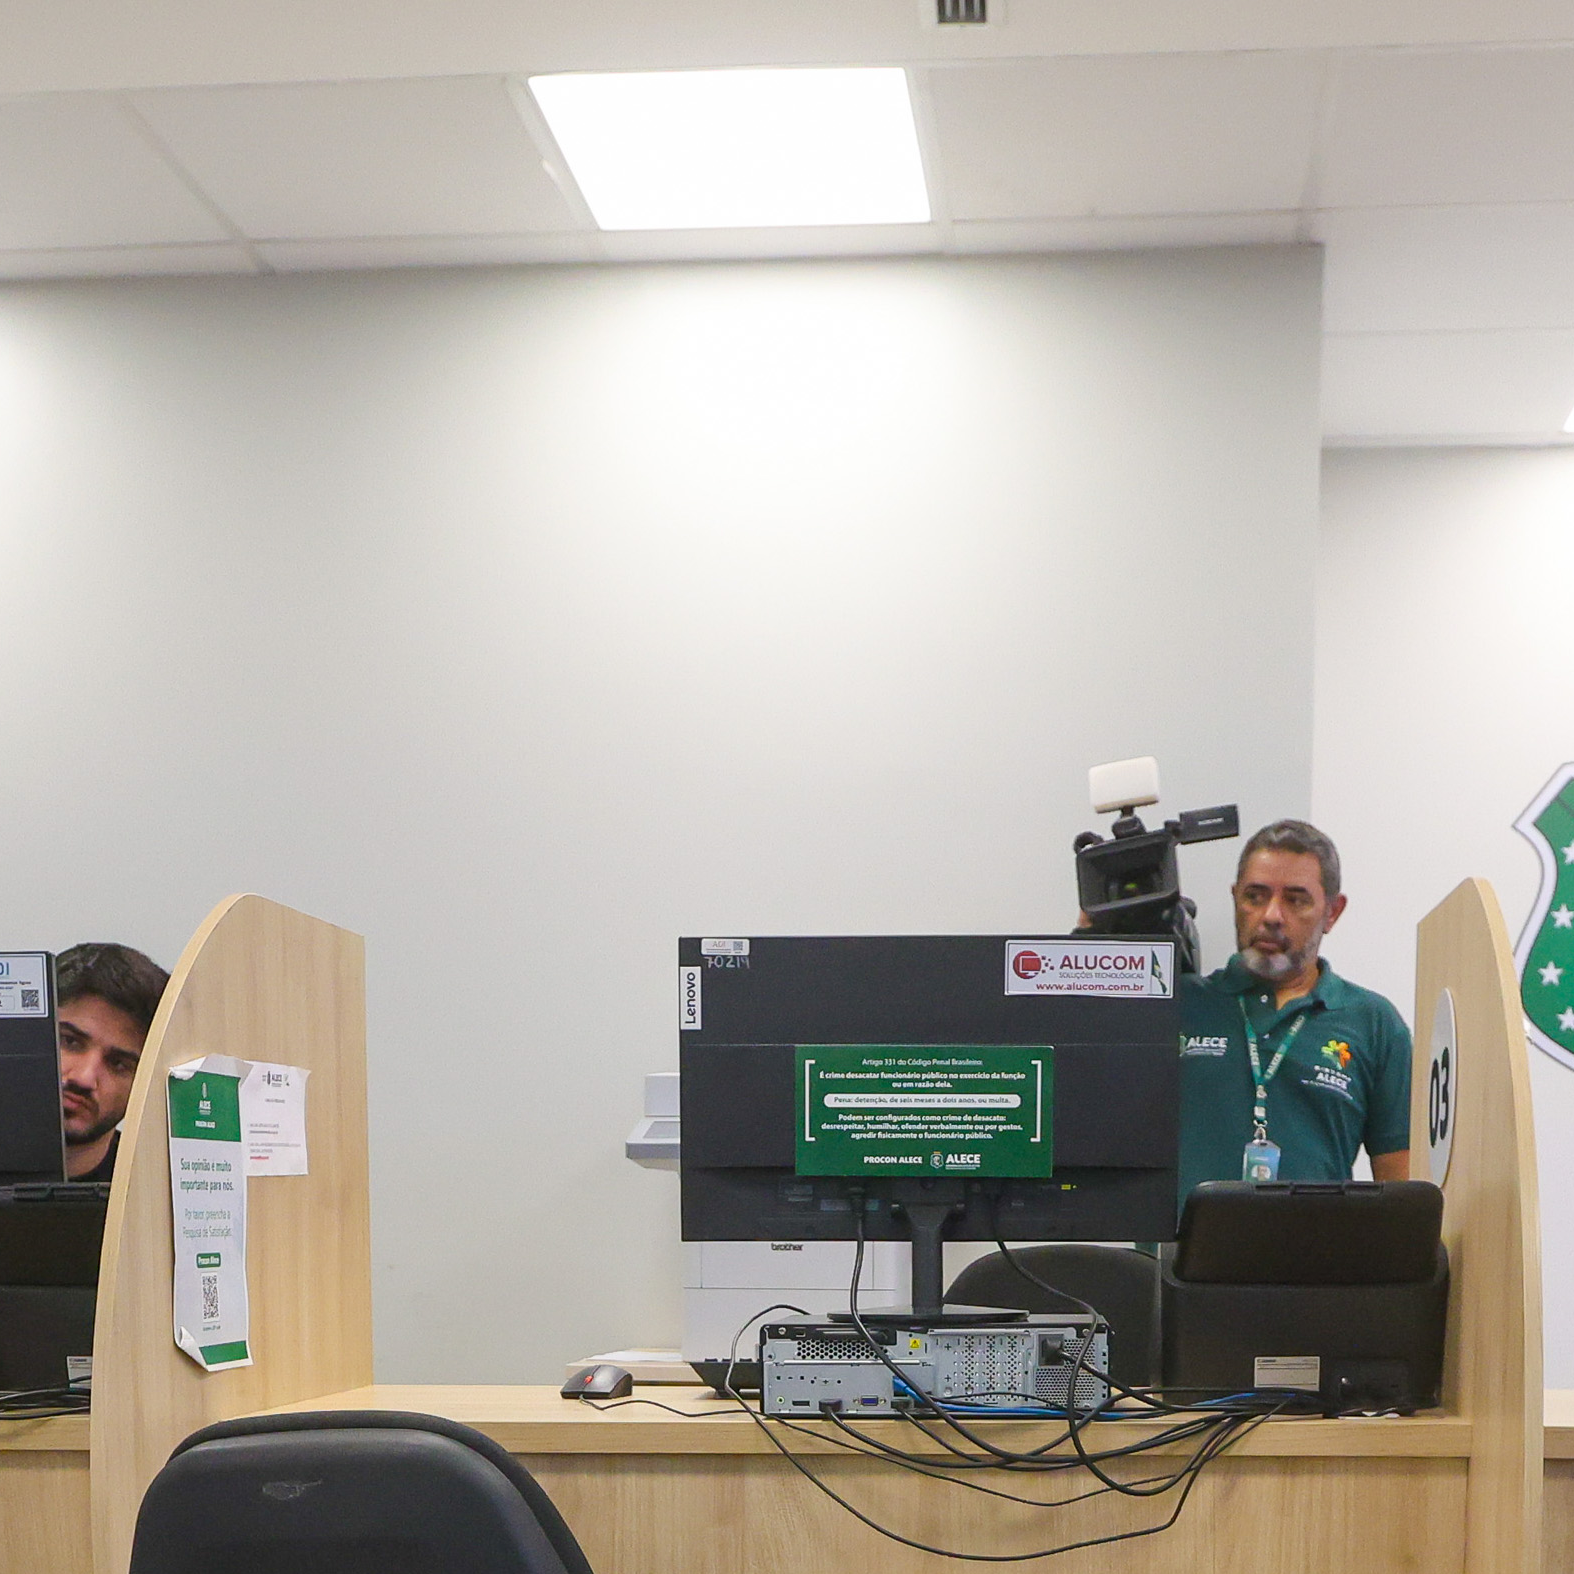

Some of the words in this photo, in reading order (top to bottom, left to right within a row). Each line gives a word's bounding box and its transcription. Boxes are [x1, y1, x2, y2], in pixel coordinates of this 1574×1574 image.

[1059, 955, 1145, 970] ALUCOM
[1059, 971, 1093, 979] SOLUÇÕES
[1095, 971, 1144, 979] TECNOLÓGICAS
[1036, 982, 1144, 991] www.alucom.com.br
[685, 972, 696, 1024] Lenovo
[1187, 1037, 1227, 1048] ALECE
[907, 1058, 931, 1066] Código
[921, 1071, 948, 1079] público
[1001, 1071, 1026, 1079] função
[1316, 1072, 1348, 1090] ALECE
[1429, 1046, 1449, 1148] 03
[875, 1114, 921, 1122] configurados
[851, 1132, 877, 1140] agredir
[965, 1132, 993, 1140] público.
[863, 1156, 897, 1164] PROCON
[898, 1156, 923, 1164] ALECE
[945, 1154, 981, 1164] ALECE
[180, 1158, 190, 1170] Sua
[191, 1158, 210, 1174] opinião
[216, 1160, 232, 1172] muito
[180, 1177, 209, 1193] importante
[210, 1181, 221, 1193] para
[771, 1242, 804, 1251] brother
